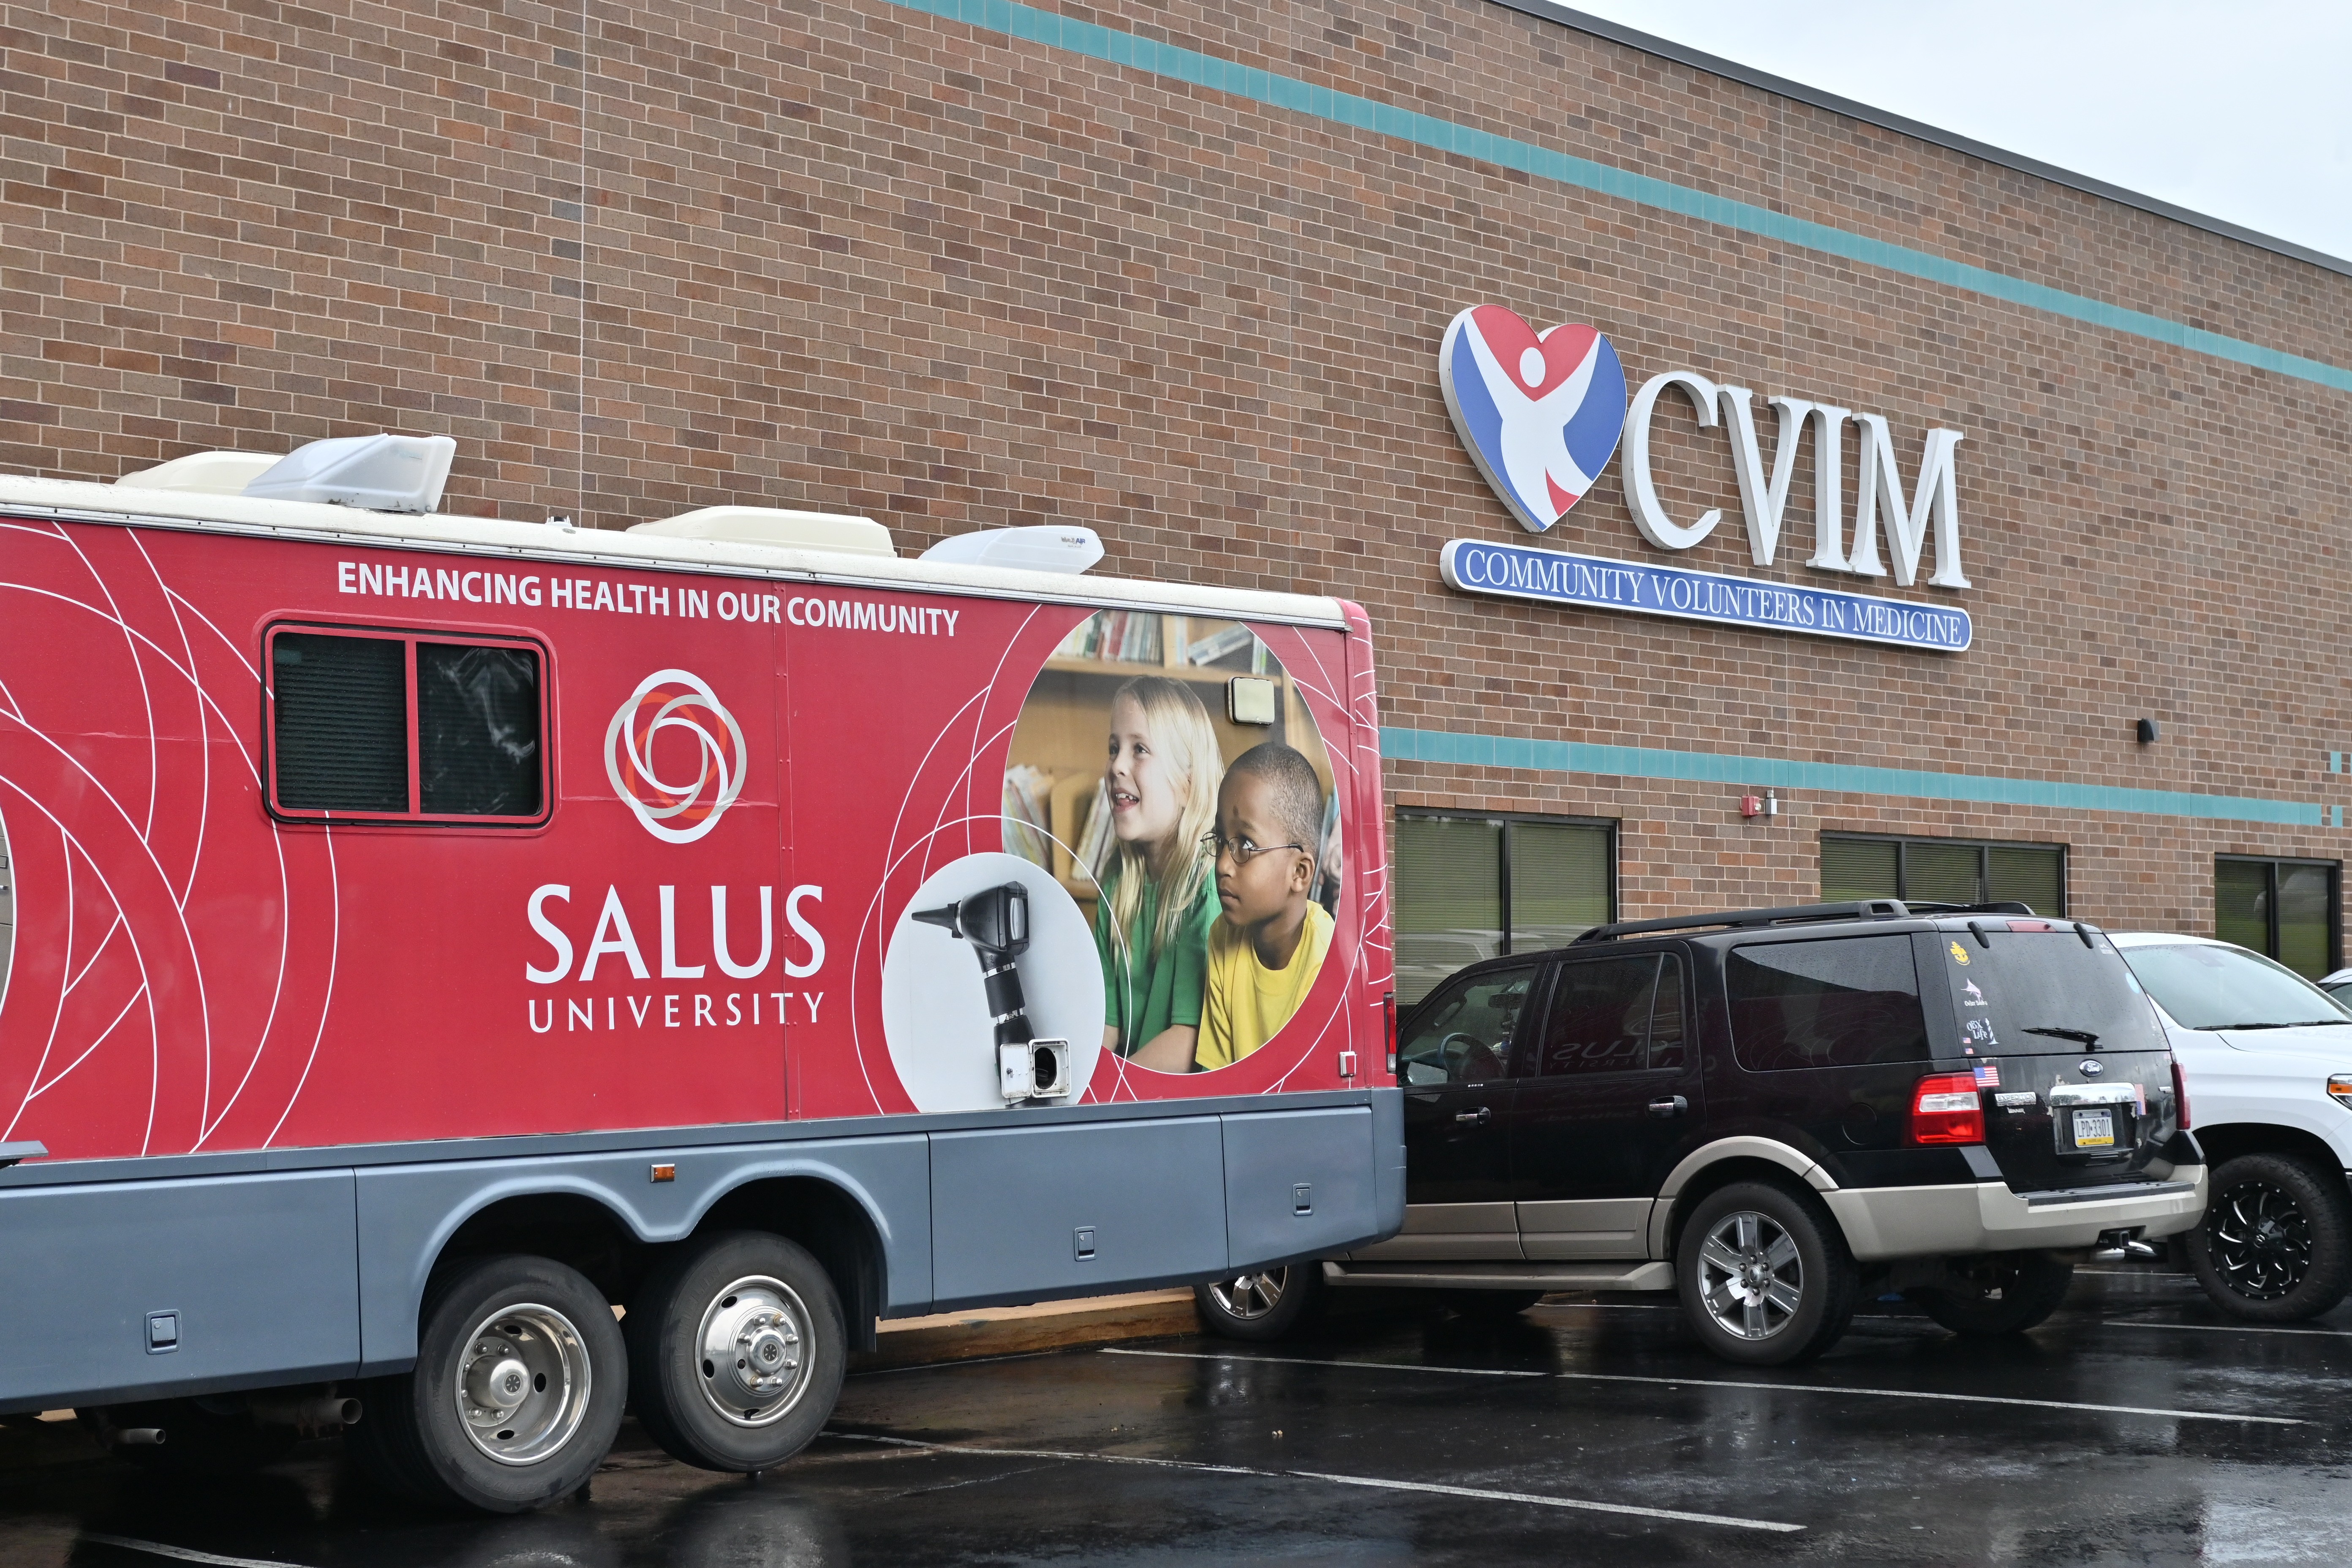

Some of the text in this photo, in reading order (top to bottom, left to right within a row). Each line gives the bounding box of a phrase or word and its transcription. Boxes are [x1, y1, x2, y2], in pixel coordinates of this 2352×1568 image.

[1622, 370, 1971, 589] CVIM
[338, 561, 959, 637] ENHANCING HEALTH IN OUR COMMUNITY
[1465, 550, 1962, 645] COMMUNITY VOLUNTEERS IN MEDICINE
[526, 884, 826, 984] SALUS
[529, 992, 825, 1034] UNIVERSITY
[1966, 1020, 1983, 1031] OBX
[1972, 1028, 1988, 1040] Life
[2086, 1063, 2101, 1072] Ford
[1997, 1094, 2035, 1102] EXPEDITION
